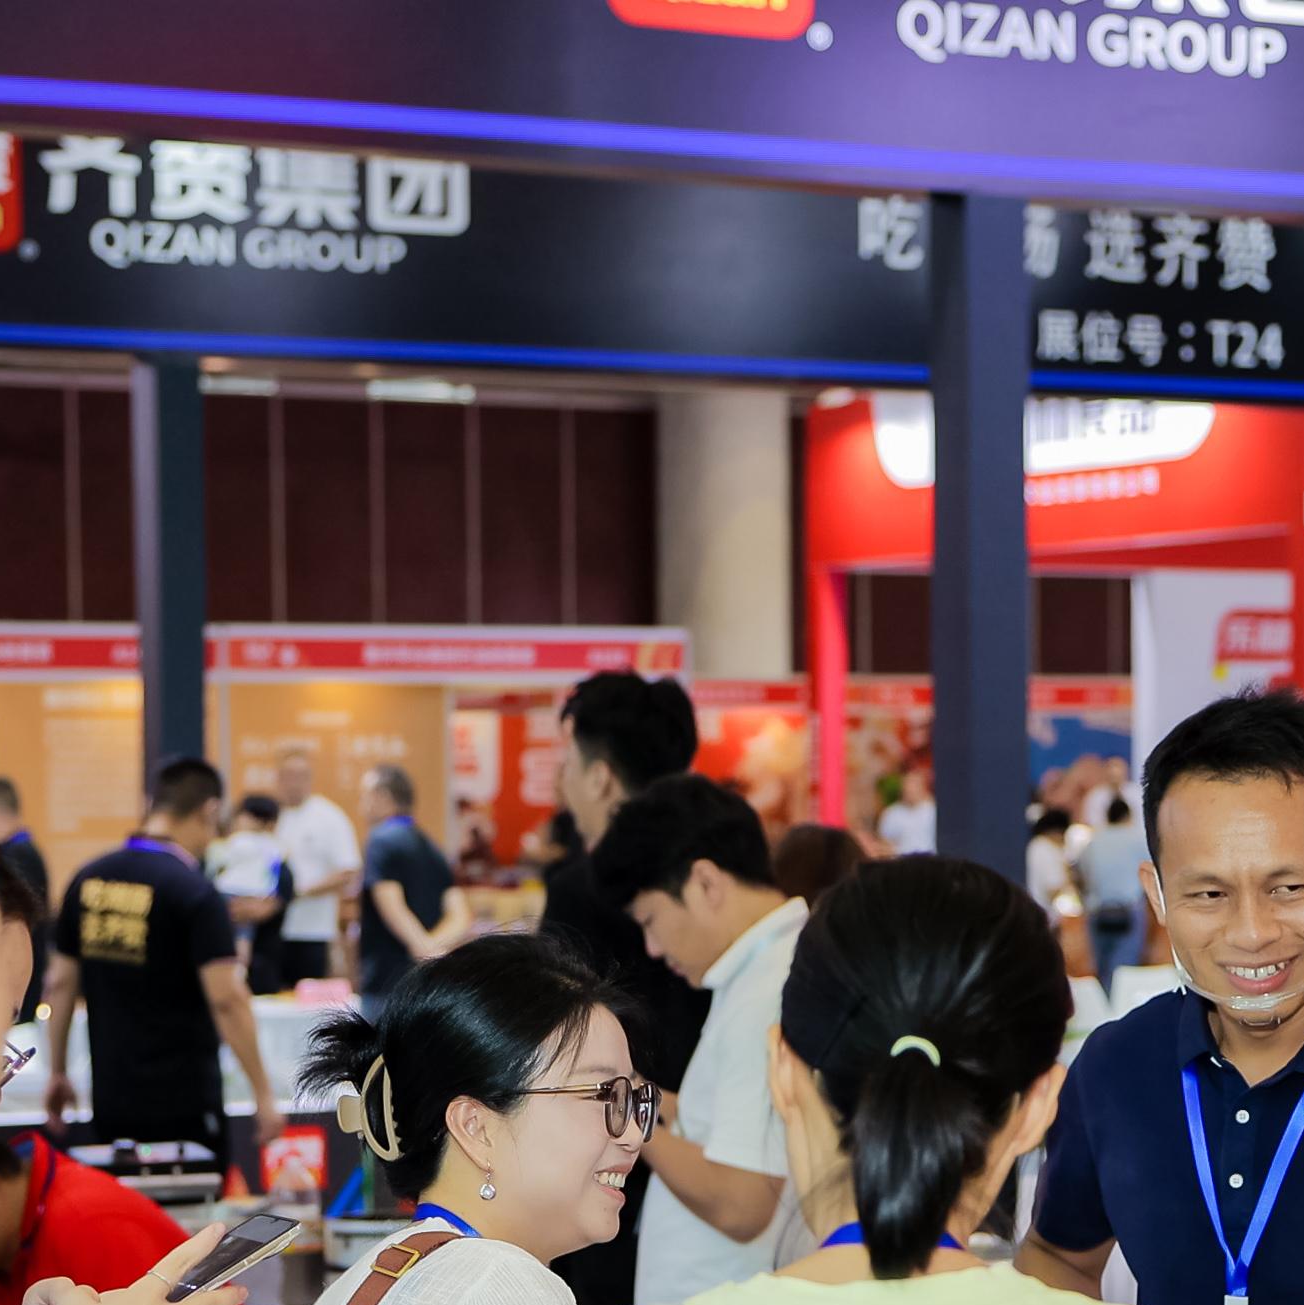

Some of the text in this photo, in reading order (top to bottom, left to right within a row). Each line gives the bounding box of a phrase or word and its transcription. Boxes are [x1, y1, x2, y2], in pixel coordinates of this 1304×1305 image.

[895, 1, 1076, 64] QIZAN
[1086, 14, 1288, 79] GROUP
[89, 218, 407, 274] QIZAN GROUP
[1084, 205, 1277, 292] 选齐赞
